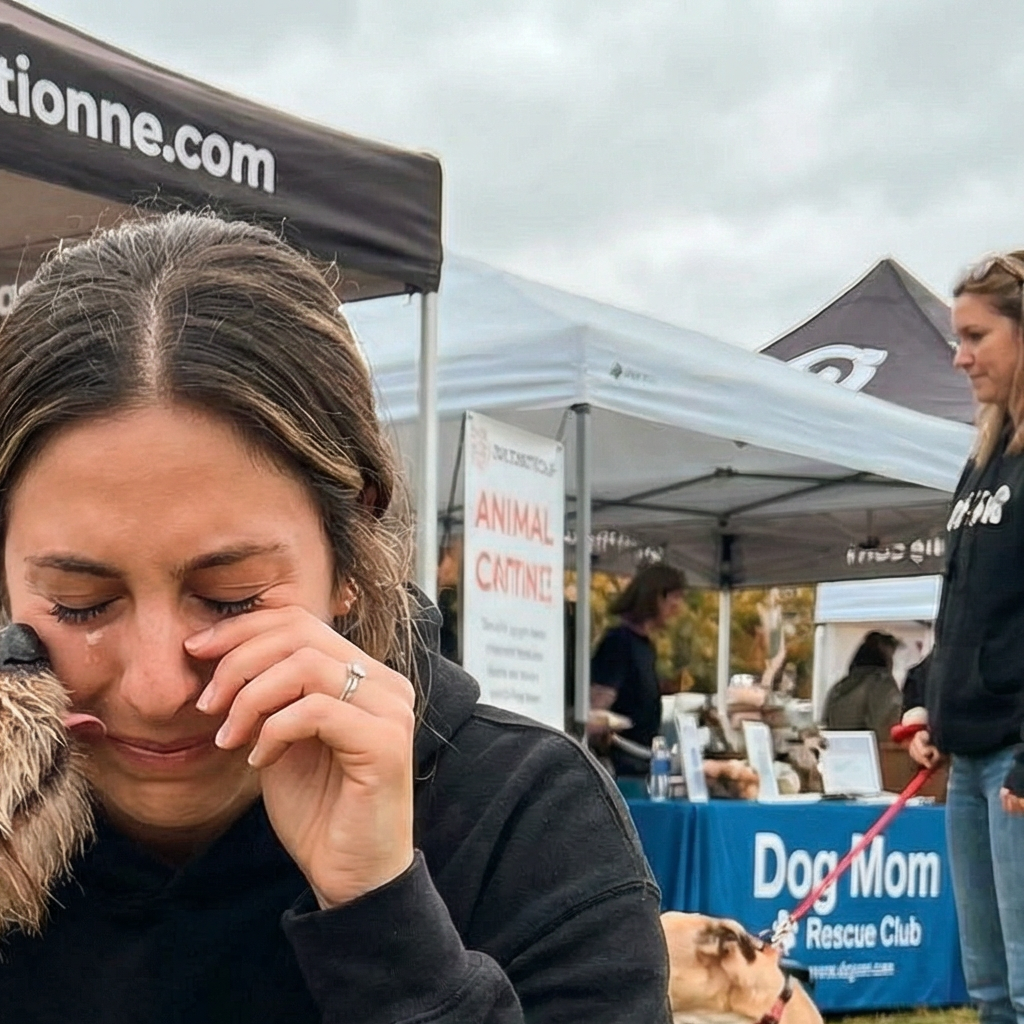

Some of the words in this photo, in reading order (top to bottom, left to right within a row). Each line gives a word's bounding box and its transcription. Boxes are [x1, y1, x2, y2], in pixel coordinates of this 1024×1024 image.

[475, 490, 554, 546] ANIMAL
[753, 831, 839, 916] Dog
[849, 832, 942, 899] Mom
[806, 915, 878, 950] Rescue
[880, 913, 923, 948] Club
